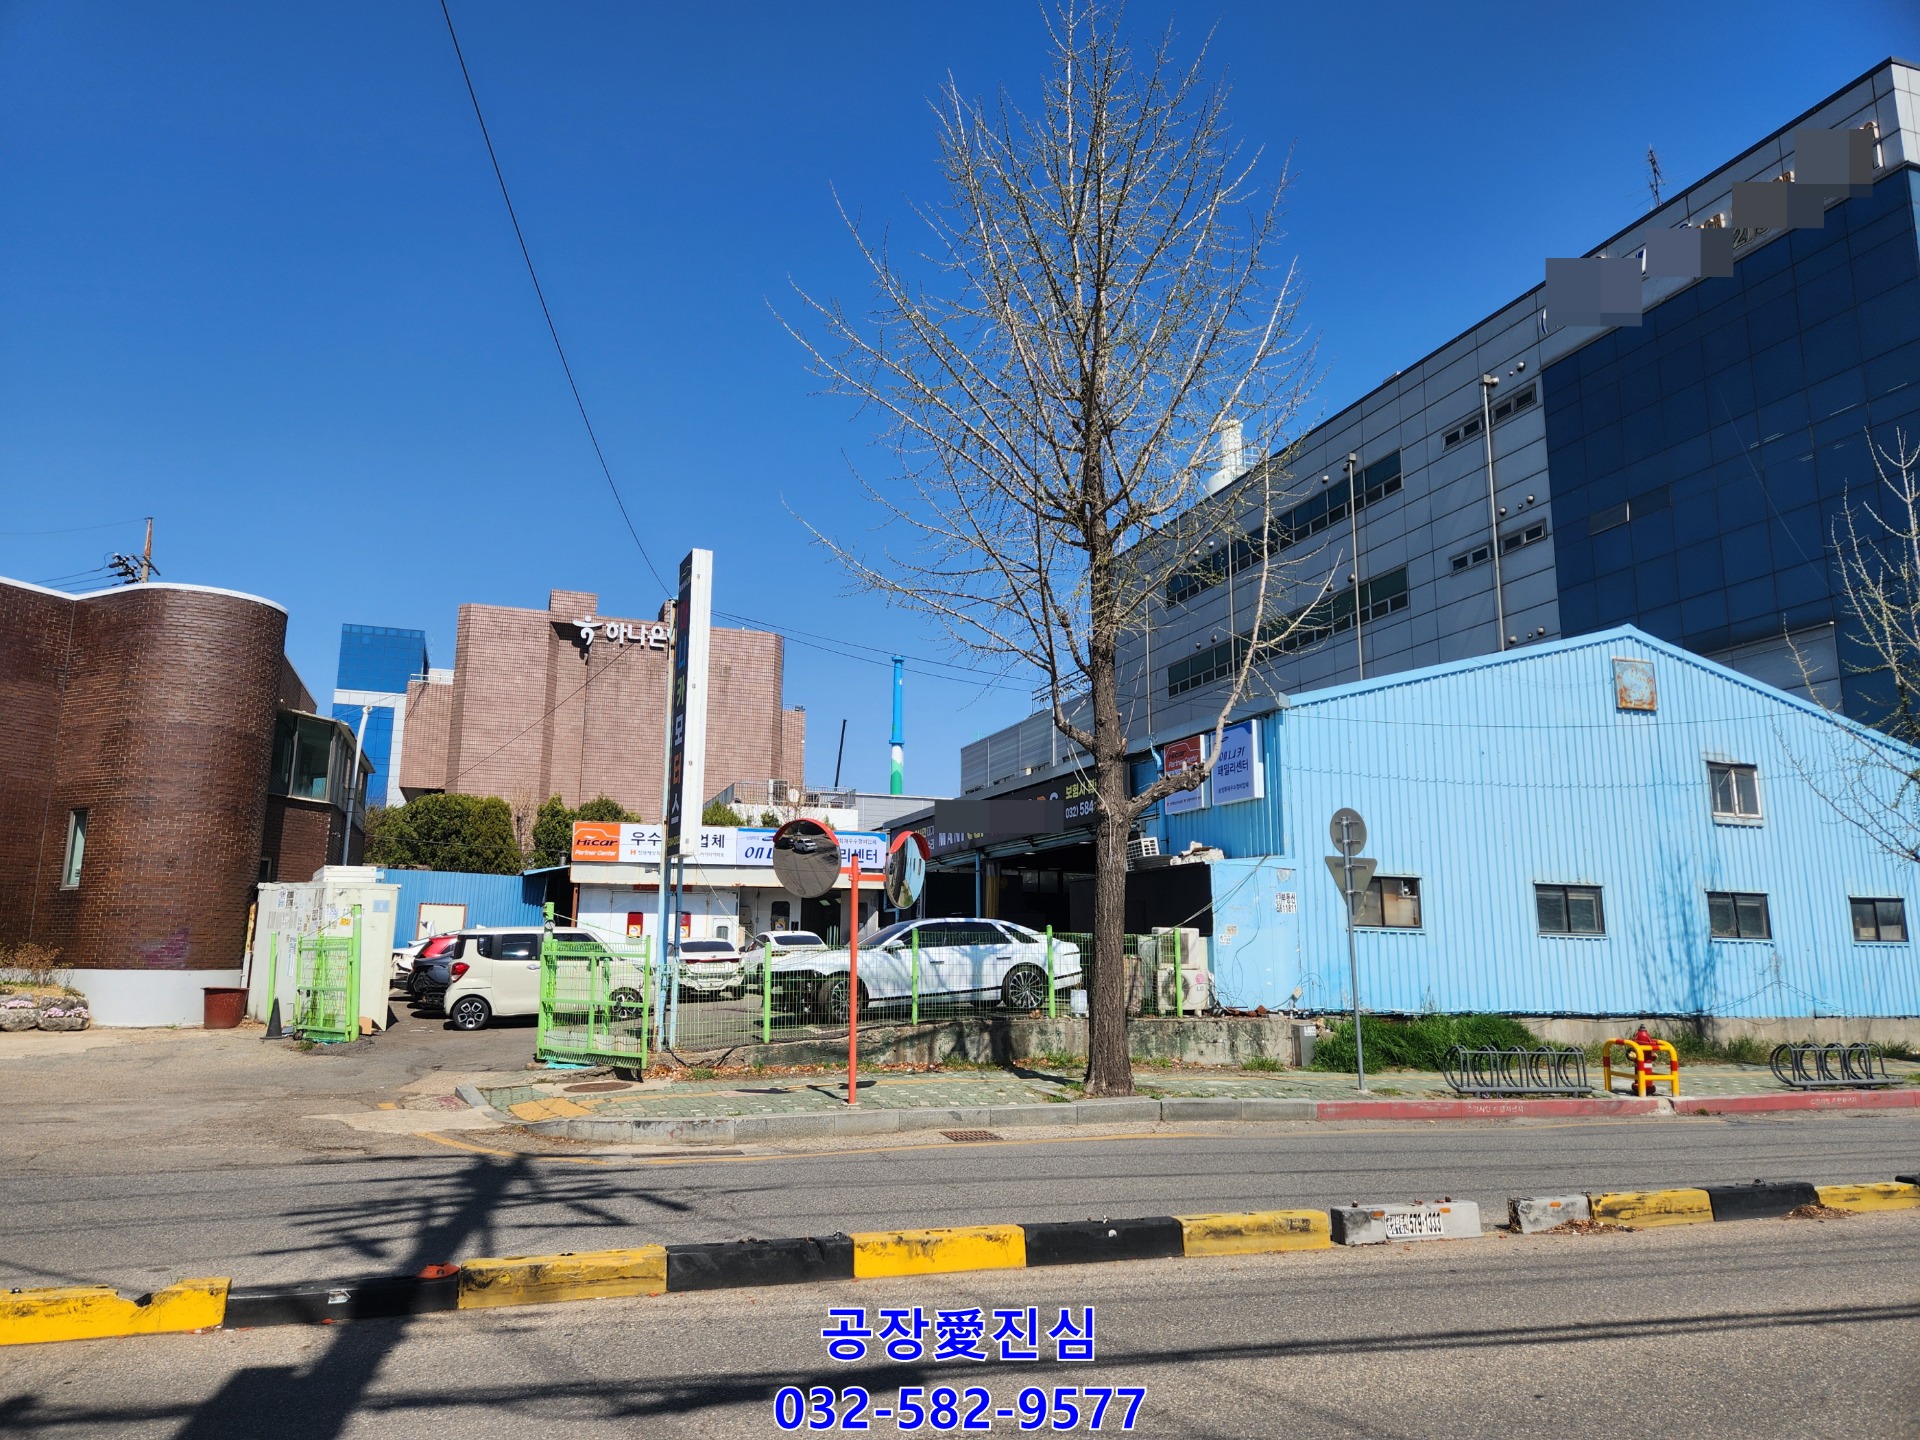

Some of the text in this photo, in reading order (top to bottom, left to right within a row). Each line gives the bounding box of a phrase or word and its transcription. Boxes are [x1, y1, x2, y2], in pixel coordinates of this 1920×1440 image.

[1217, 758, 1249, 777] 패밀리센터
[1065, 780, 1086, 800] 보험사
[1065, 804, 1079, 819] 032)
[576, 837, 619, 847] Hicar
[630, 831, 663, 847] 우수
[574, 849, 617, 857] Partner Center
[1196, 985, 1205, 993] LG
[1409, 1211, 1442, 1234] 579-1333
